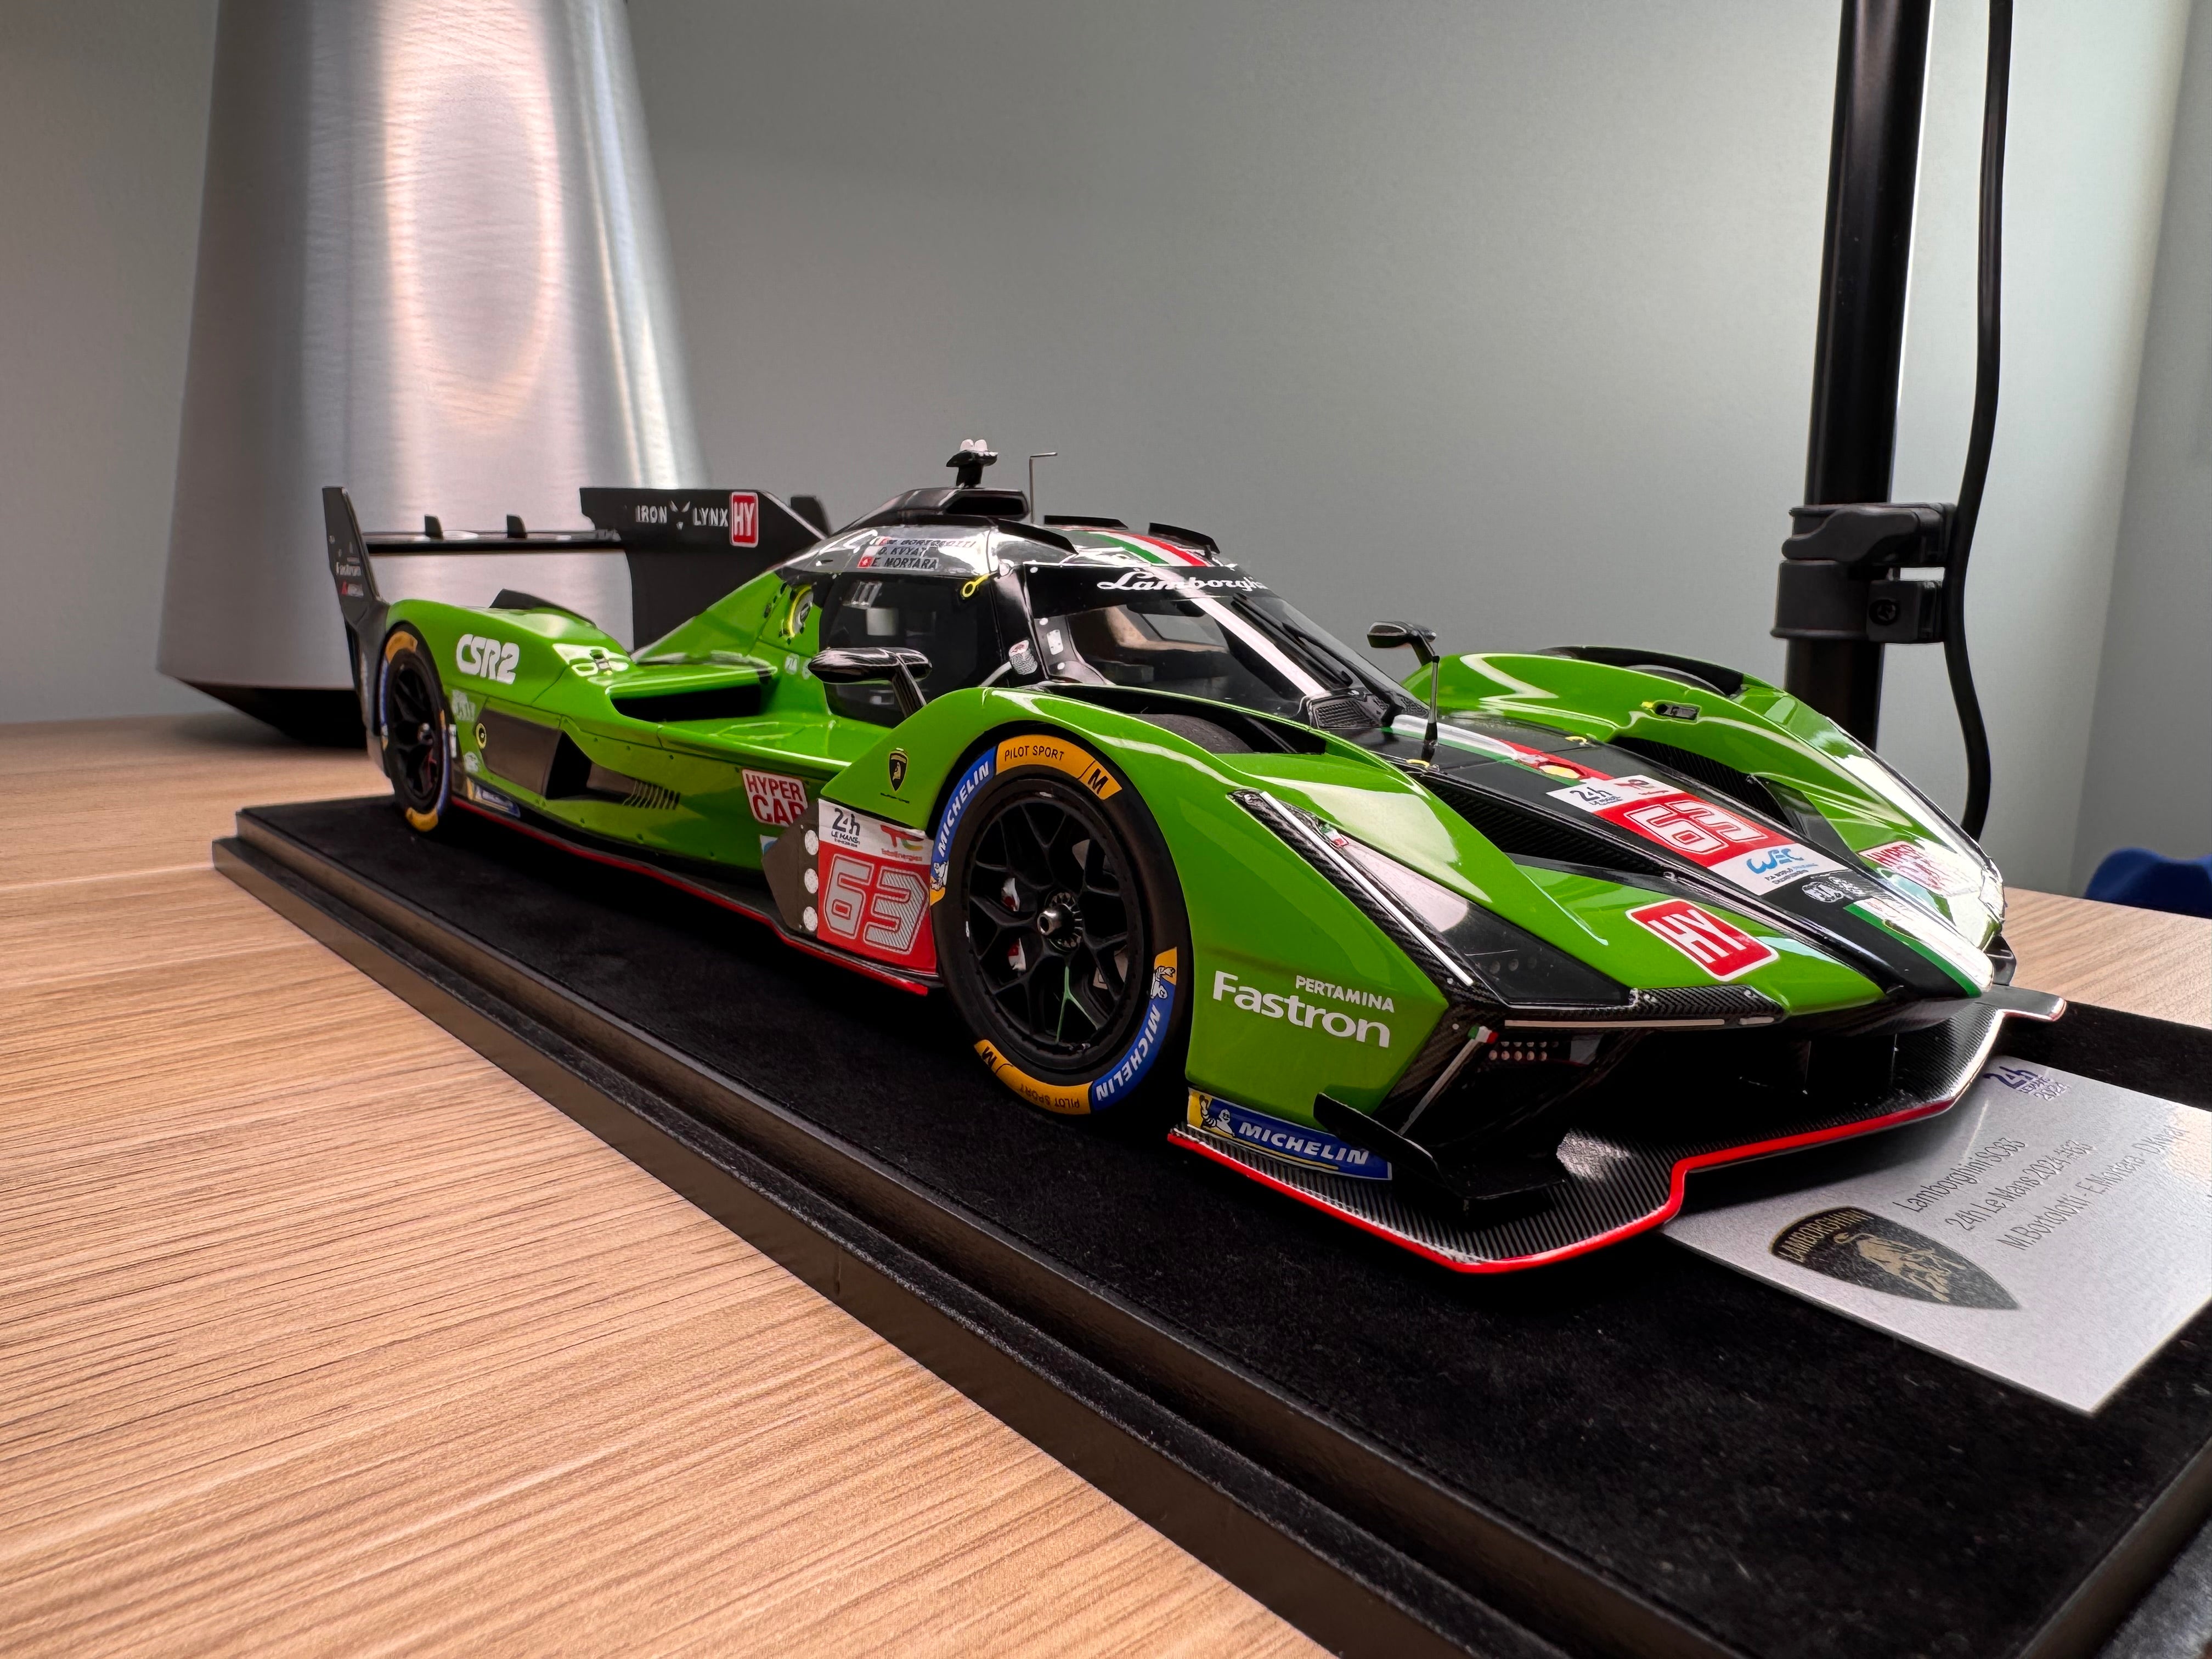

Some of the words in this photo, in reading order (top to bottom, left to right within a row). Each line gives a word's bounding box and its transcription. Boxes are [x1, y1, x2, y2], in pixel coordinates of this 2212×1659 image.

[635, 505, 667, 523] IRON
[693, 507, 729, 527] LYNX
[733, 501, 755, 536] HY
[884, 557, 938, 569] MORTARA
[456, 634, 520, 684] CSR2
[1005, 746, 1030, 761] PILOT
[1032, 745, 1064, 761] SPORT
[745, 773, 804, 802] HYPER
[1087, 768, 1109, 794] M
[1569, 787, 1613, 802] 24h
[832, 808, 861, 836] 24h
[938, 761, 989, 857] MICHELIN
[1622, 799, 1769, 856] 63
[1746, 848, 1805, 874] WEC
[823, 853, 930, 956] 63
[1647, 909, 1747, 964] HY
[1295, 974, 1395, 1013] PERTAMINA
[1212, 970, 1391, 1048] Fastron
[1096, 1005, 1161, 1102] MICHELIN
[1982, 1066, 2039, 1089] 24h
[1054, 1098, 1080, 1108] PILOT
[1238, 1122, 1369, 1165] MICHELIN
[2022, 1154, 2072, 1180] 2024
[1892, 1157, 1995, 1213] Lamborghini
[1987, 1176, 2040, 1203] Mans
[1945, 1210, 1993, 1231] 24h
[1970, 1199, 2007, 1214] Le
